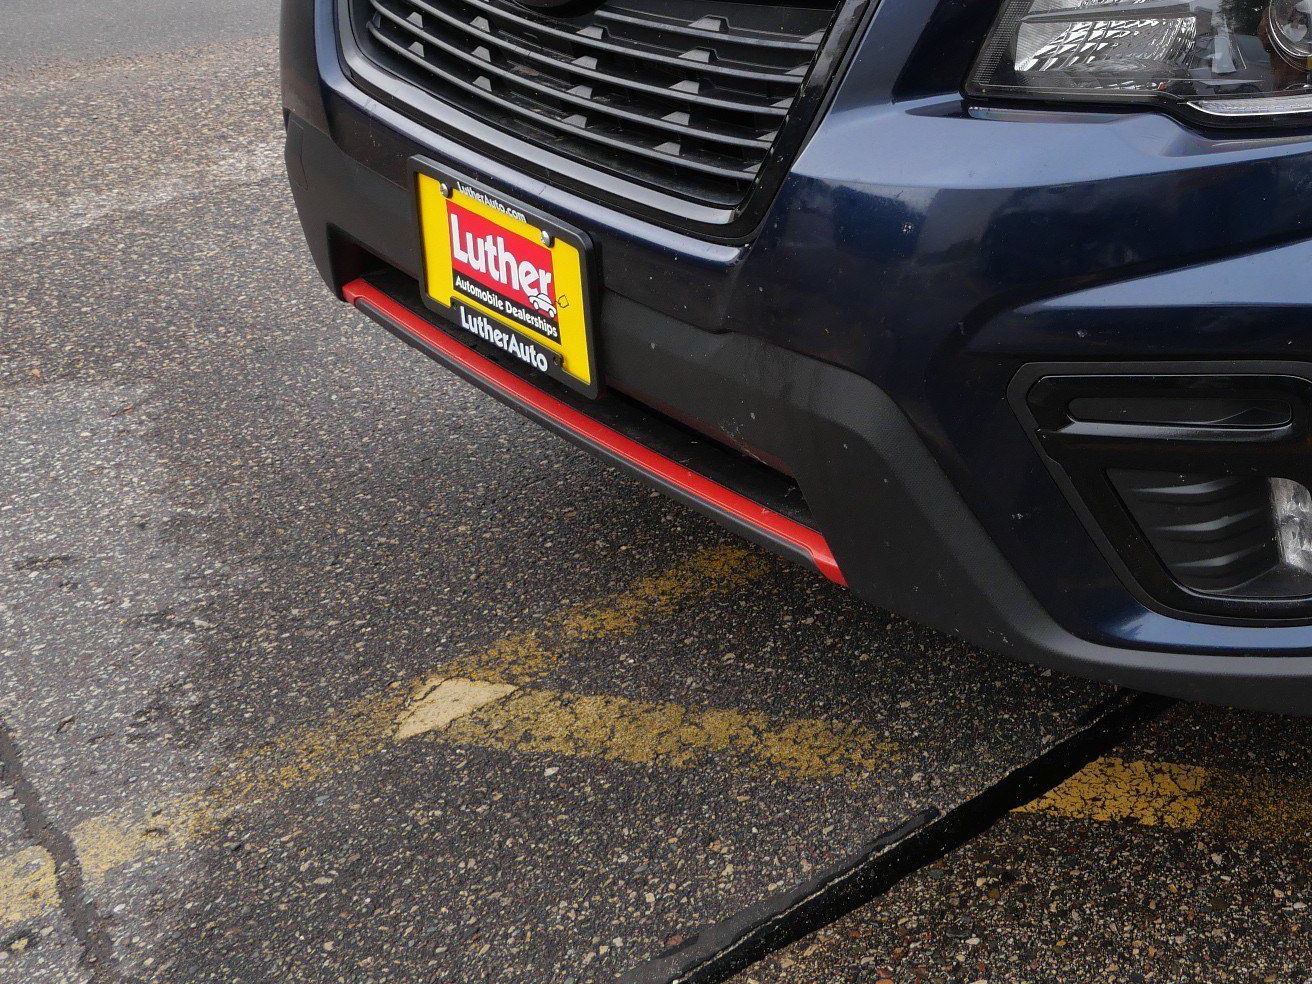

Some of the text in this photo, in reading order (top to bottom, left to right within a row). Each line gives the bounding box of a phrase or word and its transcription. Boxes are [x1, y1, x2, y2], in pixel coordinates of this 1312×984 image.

[457, 181, 527, 223] LutherAuto.com
[450, 213, 552, 296] Luther
[455, 275, 558, 337] Automobile Dealerships
[460, 305, 548, 372] LutherAuto
